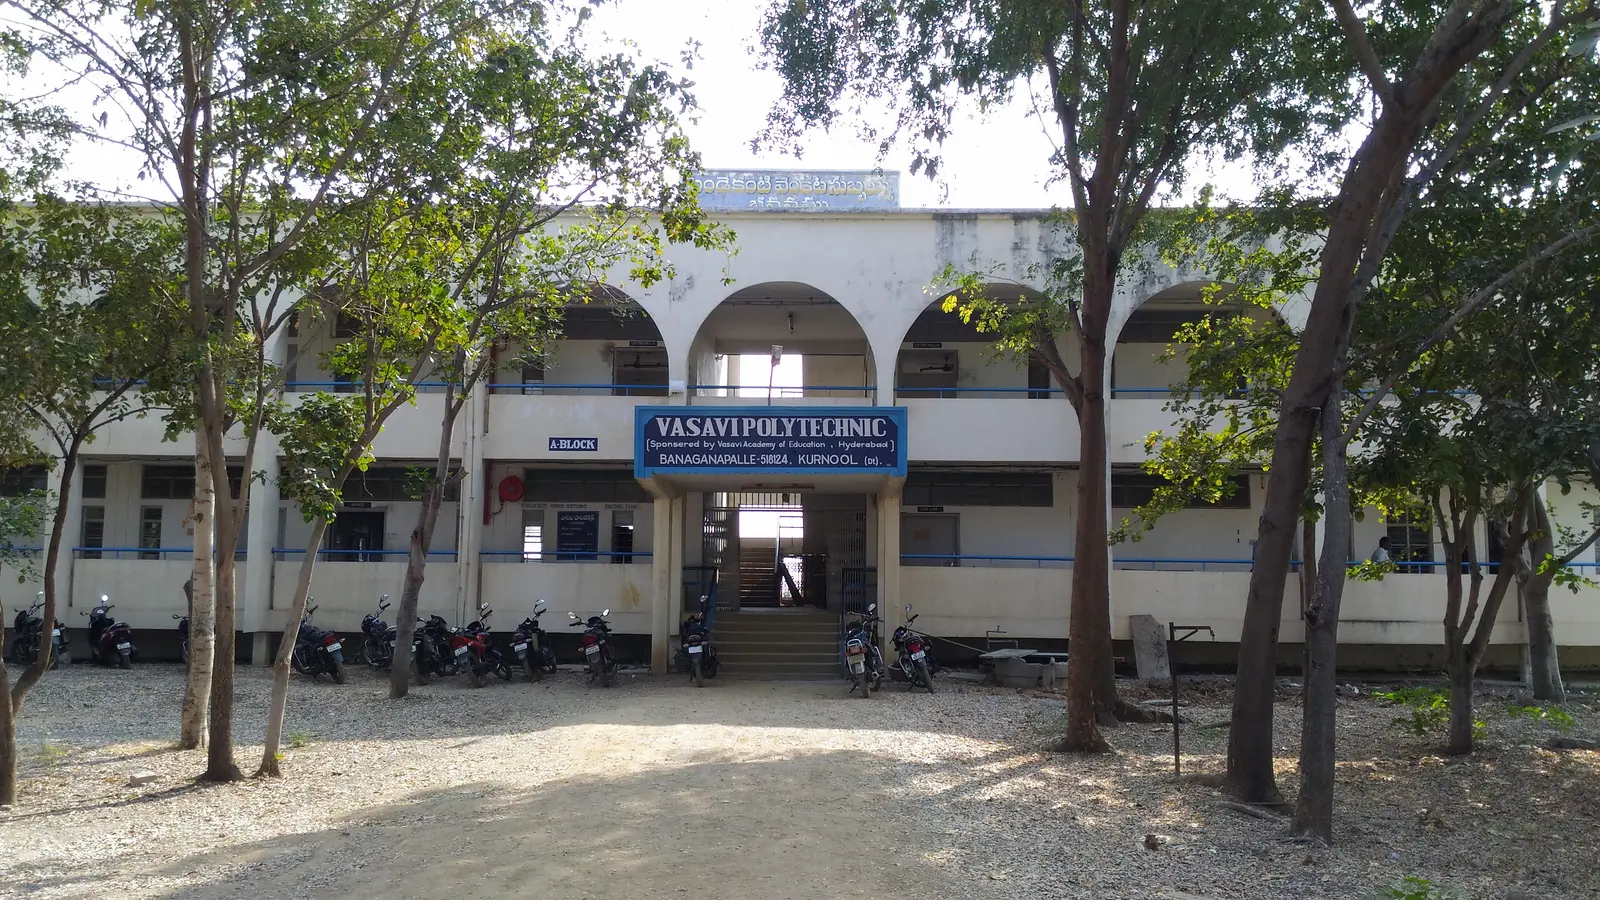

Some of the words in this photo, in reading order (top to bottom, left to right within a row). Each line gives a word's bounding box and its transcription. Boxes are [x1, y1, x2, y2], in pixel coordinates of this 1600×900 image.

[655, 417, 740, 437] VASAVI
[742, 417, 887, 437] POLYTECHNIC
[550, 439, 596, 449] A-BLOCK
[703, 440, 716, 450] by
[743, 440, 776, 450] Academy
[798, 454, 859, 465] KURNOOL
